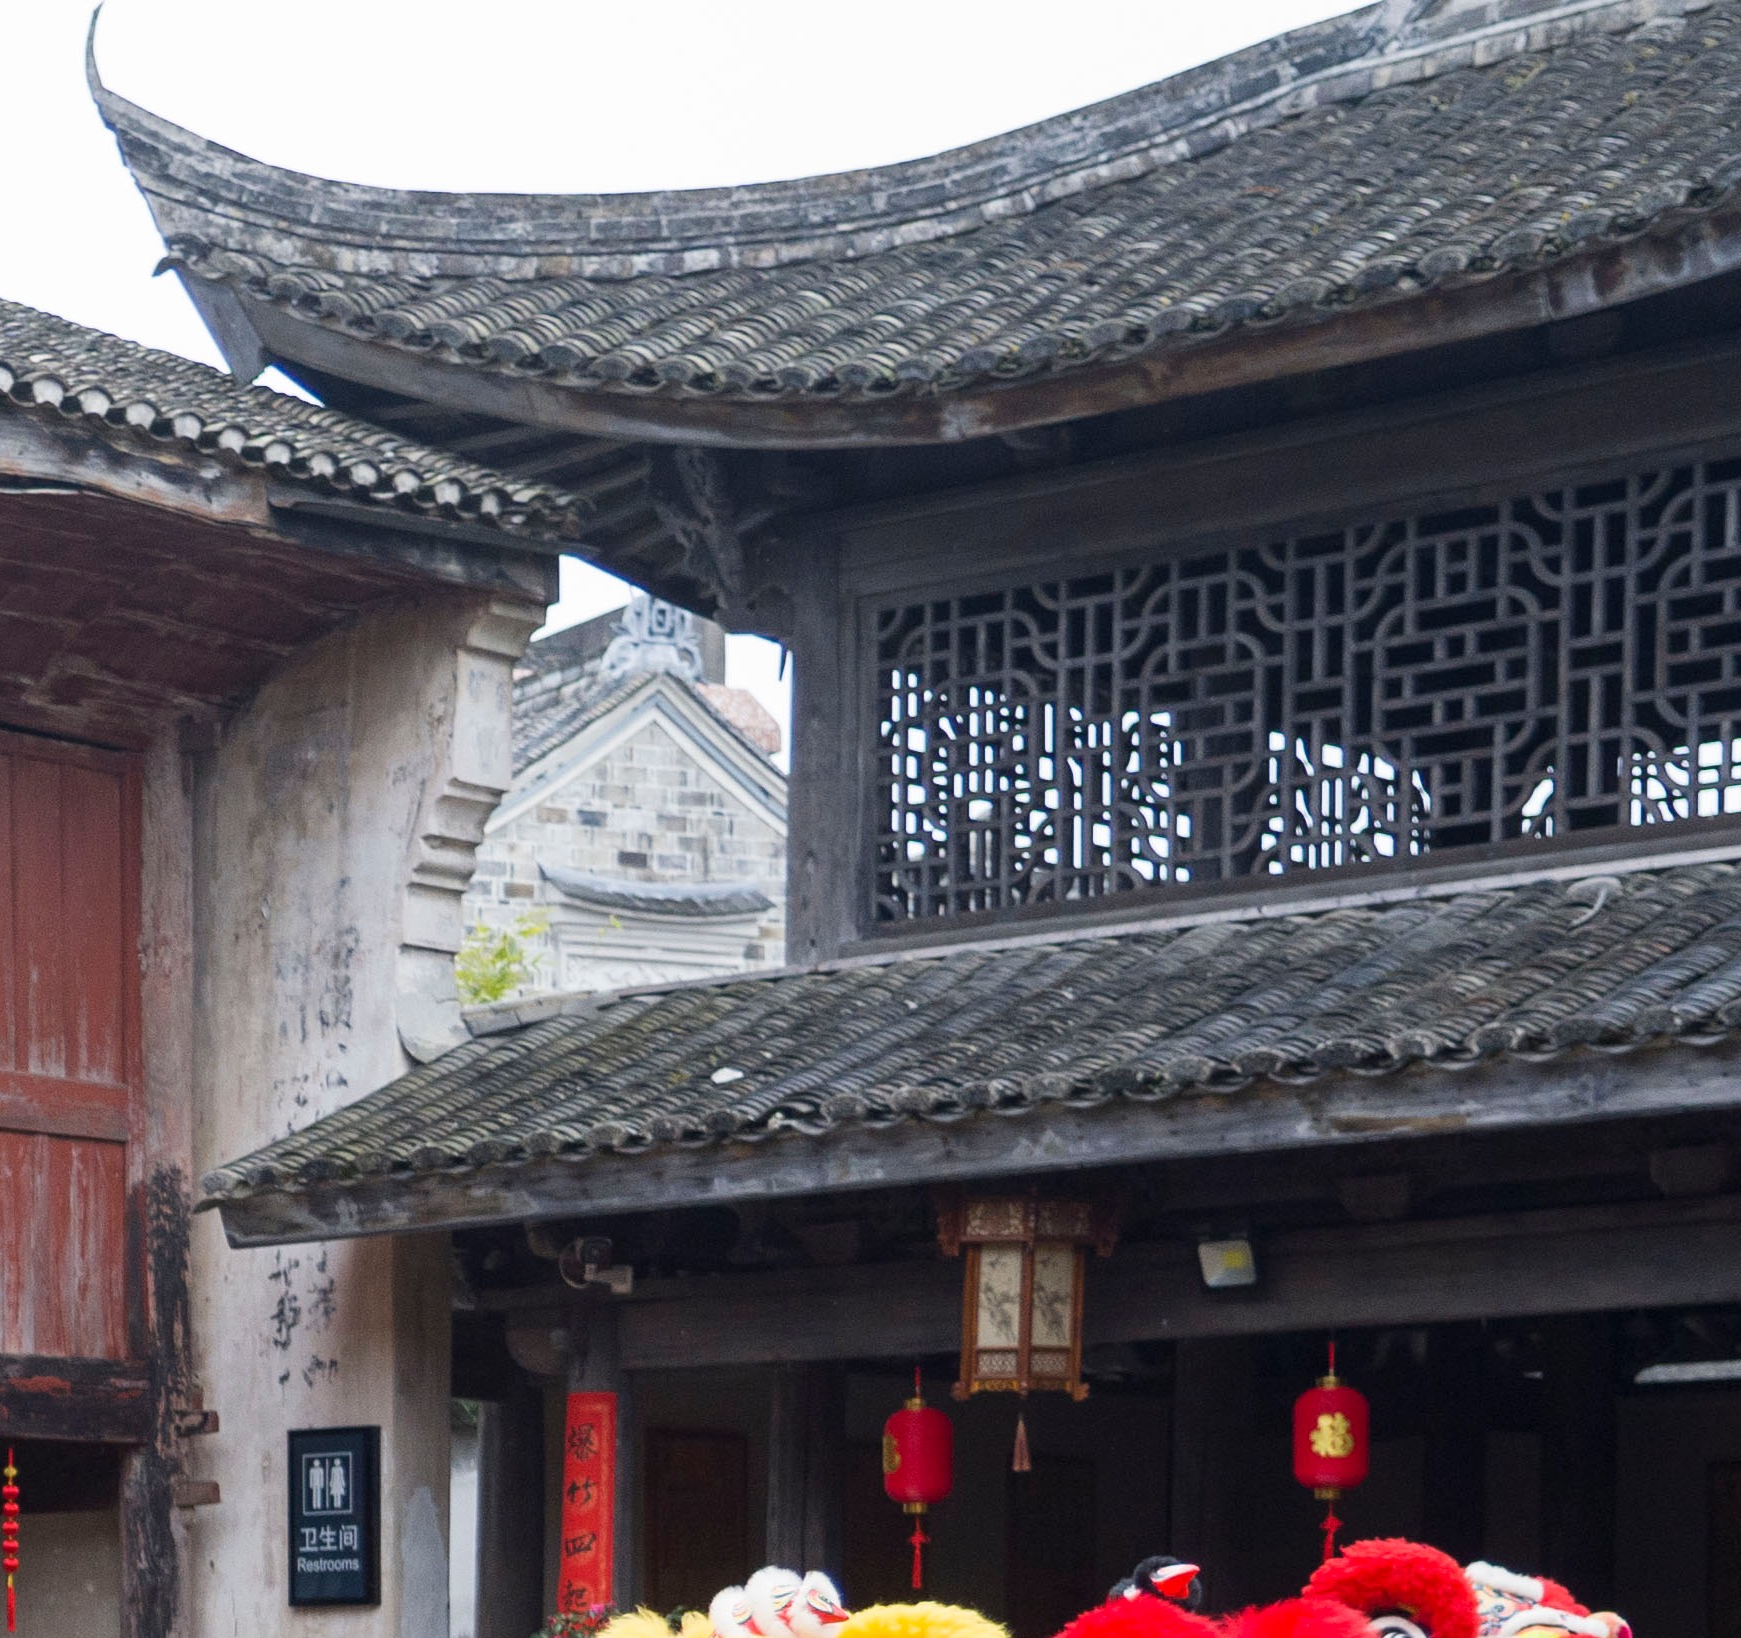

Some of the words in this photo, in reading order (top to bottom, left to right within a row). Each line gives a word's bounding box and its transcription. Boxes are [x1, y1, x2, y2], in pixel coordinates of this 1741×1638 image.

[1308, 1410, 1356, 1459] 福
[298, 1524, 359, 1553] 卫生间
[297, 1556, 360, 1573] Restrooms
